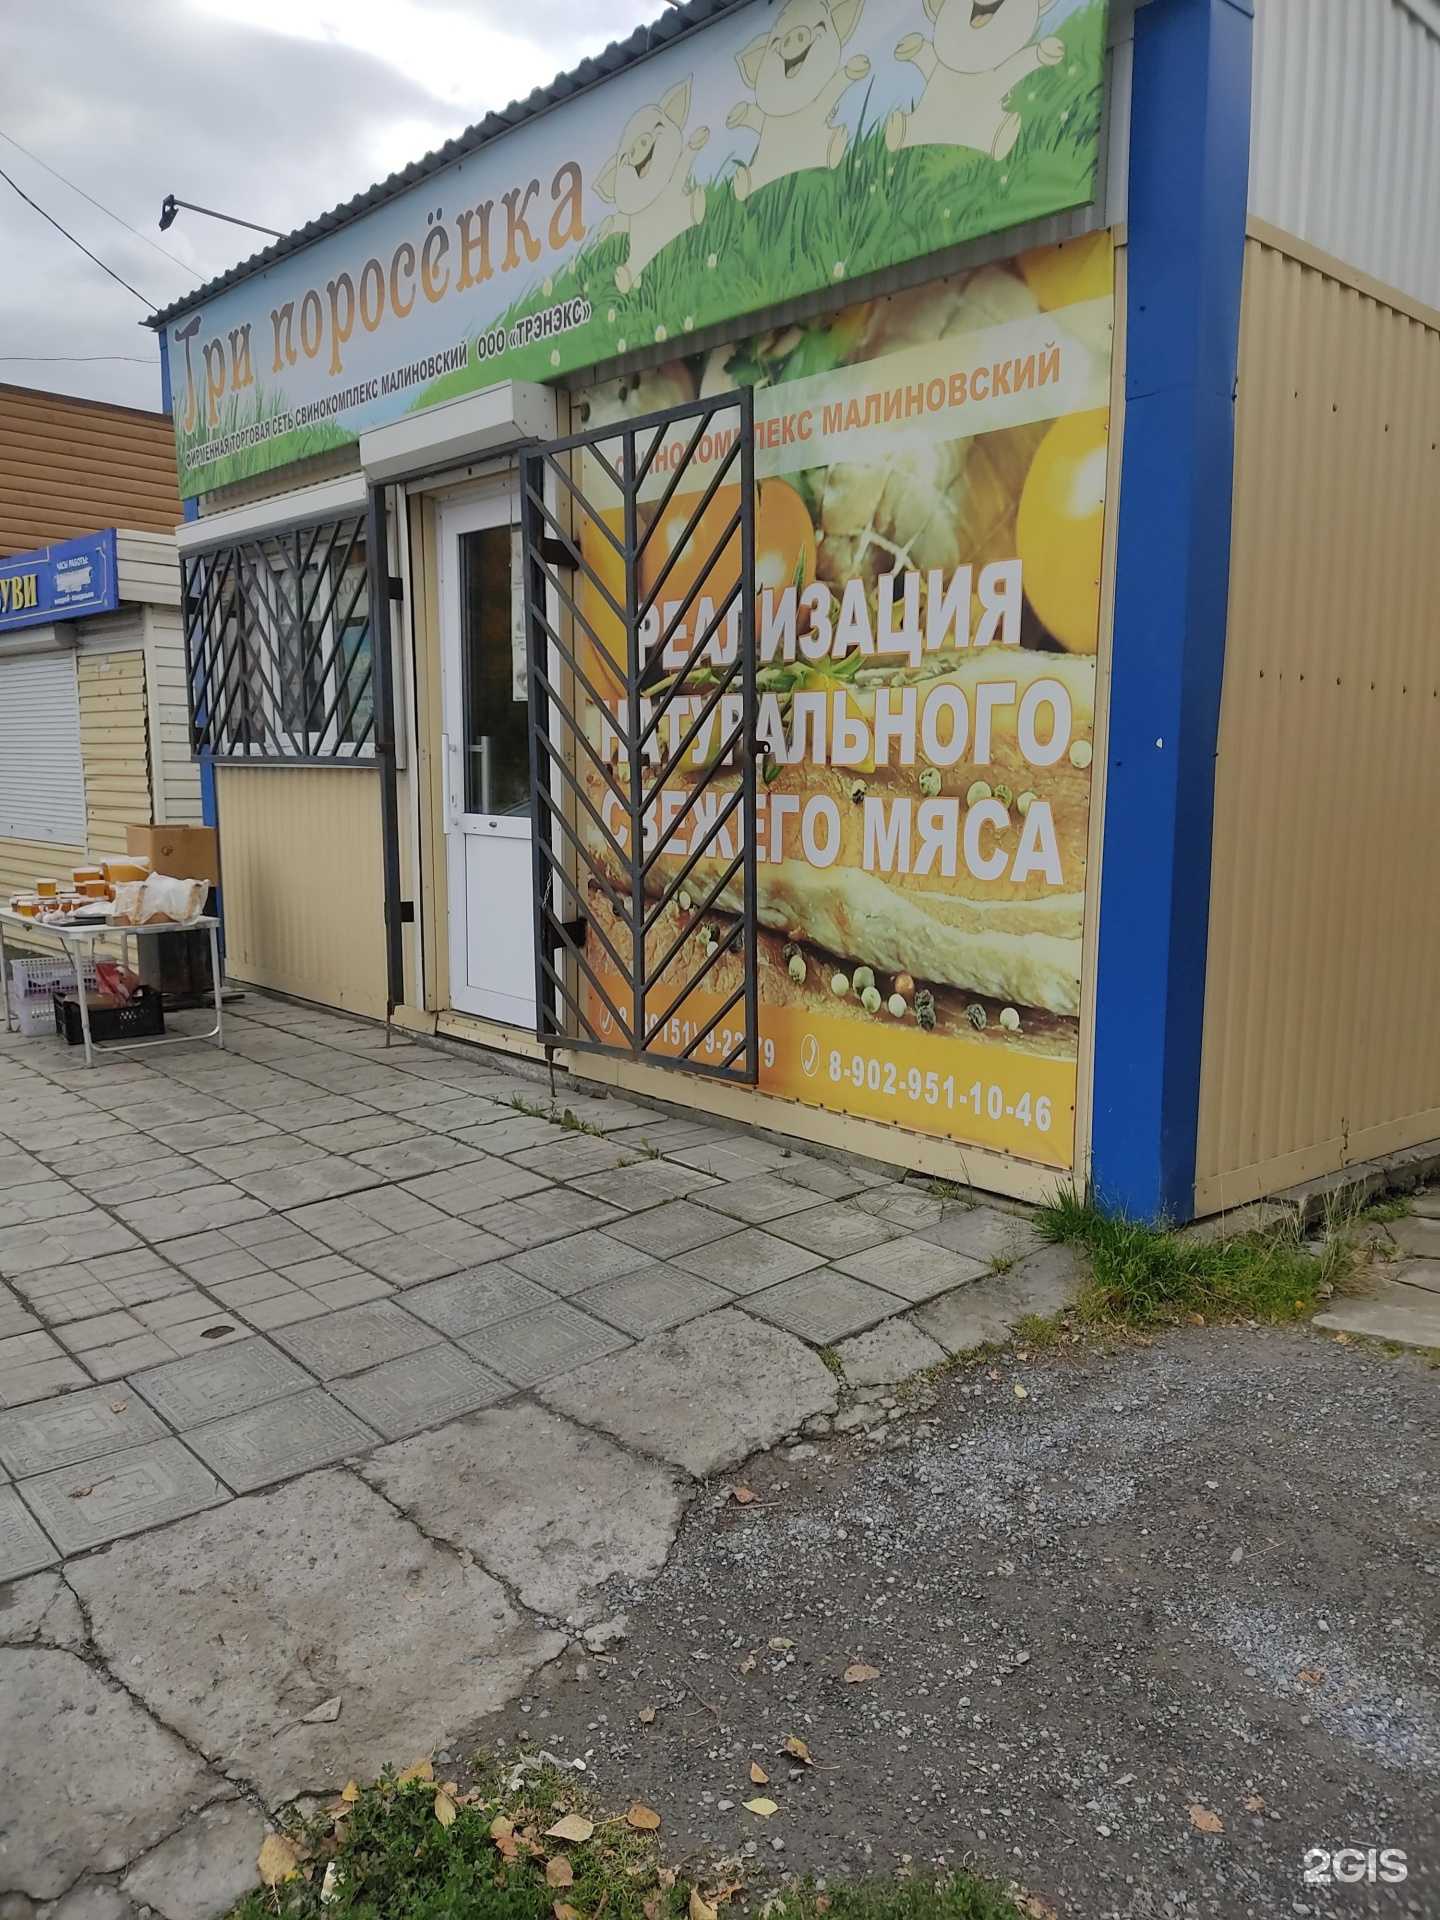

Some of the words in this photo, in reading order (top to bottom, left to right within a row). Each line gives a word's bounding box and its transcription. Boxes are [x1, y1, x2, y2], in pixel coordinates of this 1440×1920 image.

[174, 315, 254, 432] Три
[270, 160, 587, 377] поросёнка
[231, 421, 270, 453] ТОРГОВАЯ
[272, 411, 293, 435] СЕТЬ
[295, 380, 379, 427] СВИНОКОМПЛЕКС
[381, 340, 468, 396] МАЛИНОВСКИЙ
[478, 328, 506, 359] ООО
[509, 299, 591, 347] «ТРЭНЭКС»
[821, 341, 1061, 434] МАЛИНОВСКИЙ
[0, 574, 38, 613] УВИ
[638, 559, 1023, 669] РЕАЛИЗАЦИЯ
[601, 678, 1074, 766] НАТУРАЛЬНОГО
[601, 788, 842, 869] СВЕЖЕГО
[862, 795, 1065, 885] МЯСА
[828, 1050, 1052, 1131] 8-902-951-10-46
